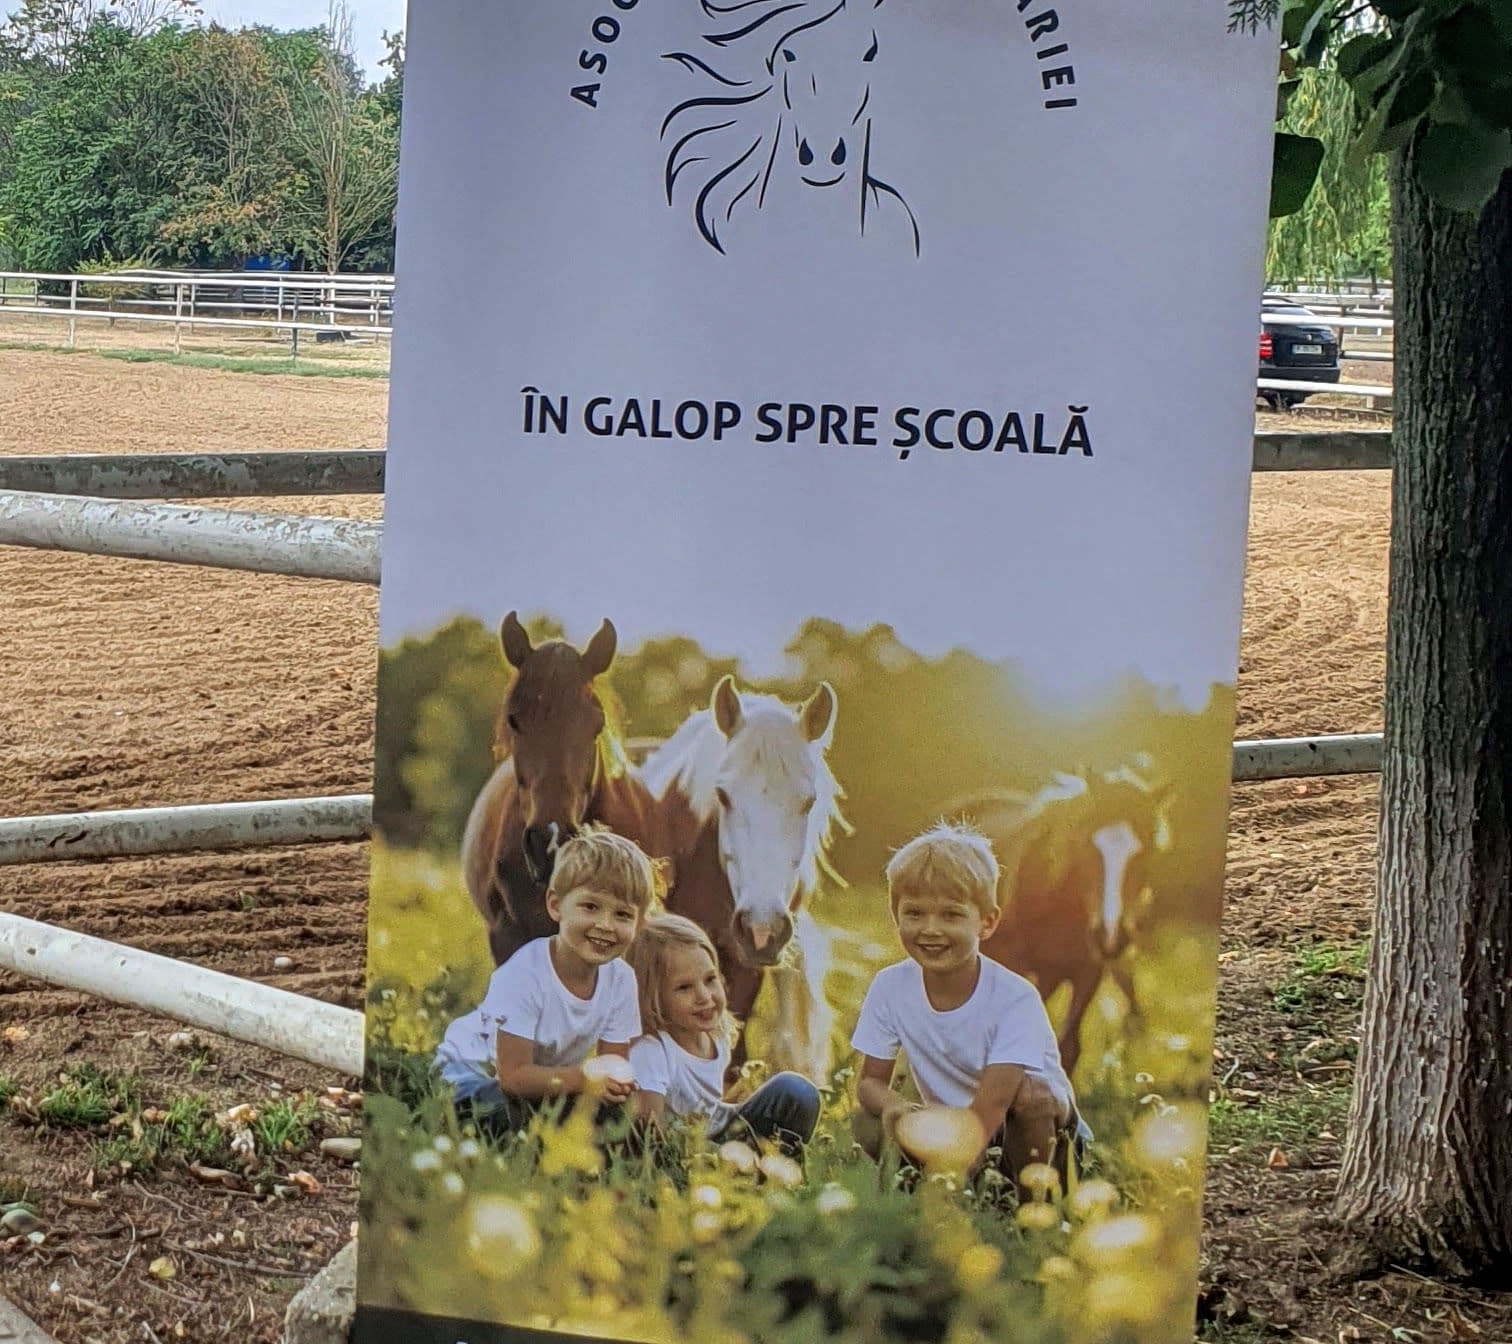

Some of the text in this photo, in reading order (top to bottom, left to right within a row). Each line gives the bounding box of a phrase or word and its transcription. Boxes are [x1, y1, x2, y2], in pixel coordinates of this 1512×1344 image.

[520, 386, 1094, 460] ÎN GALOP SPRE ȘCOALĂ
